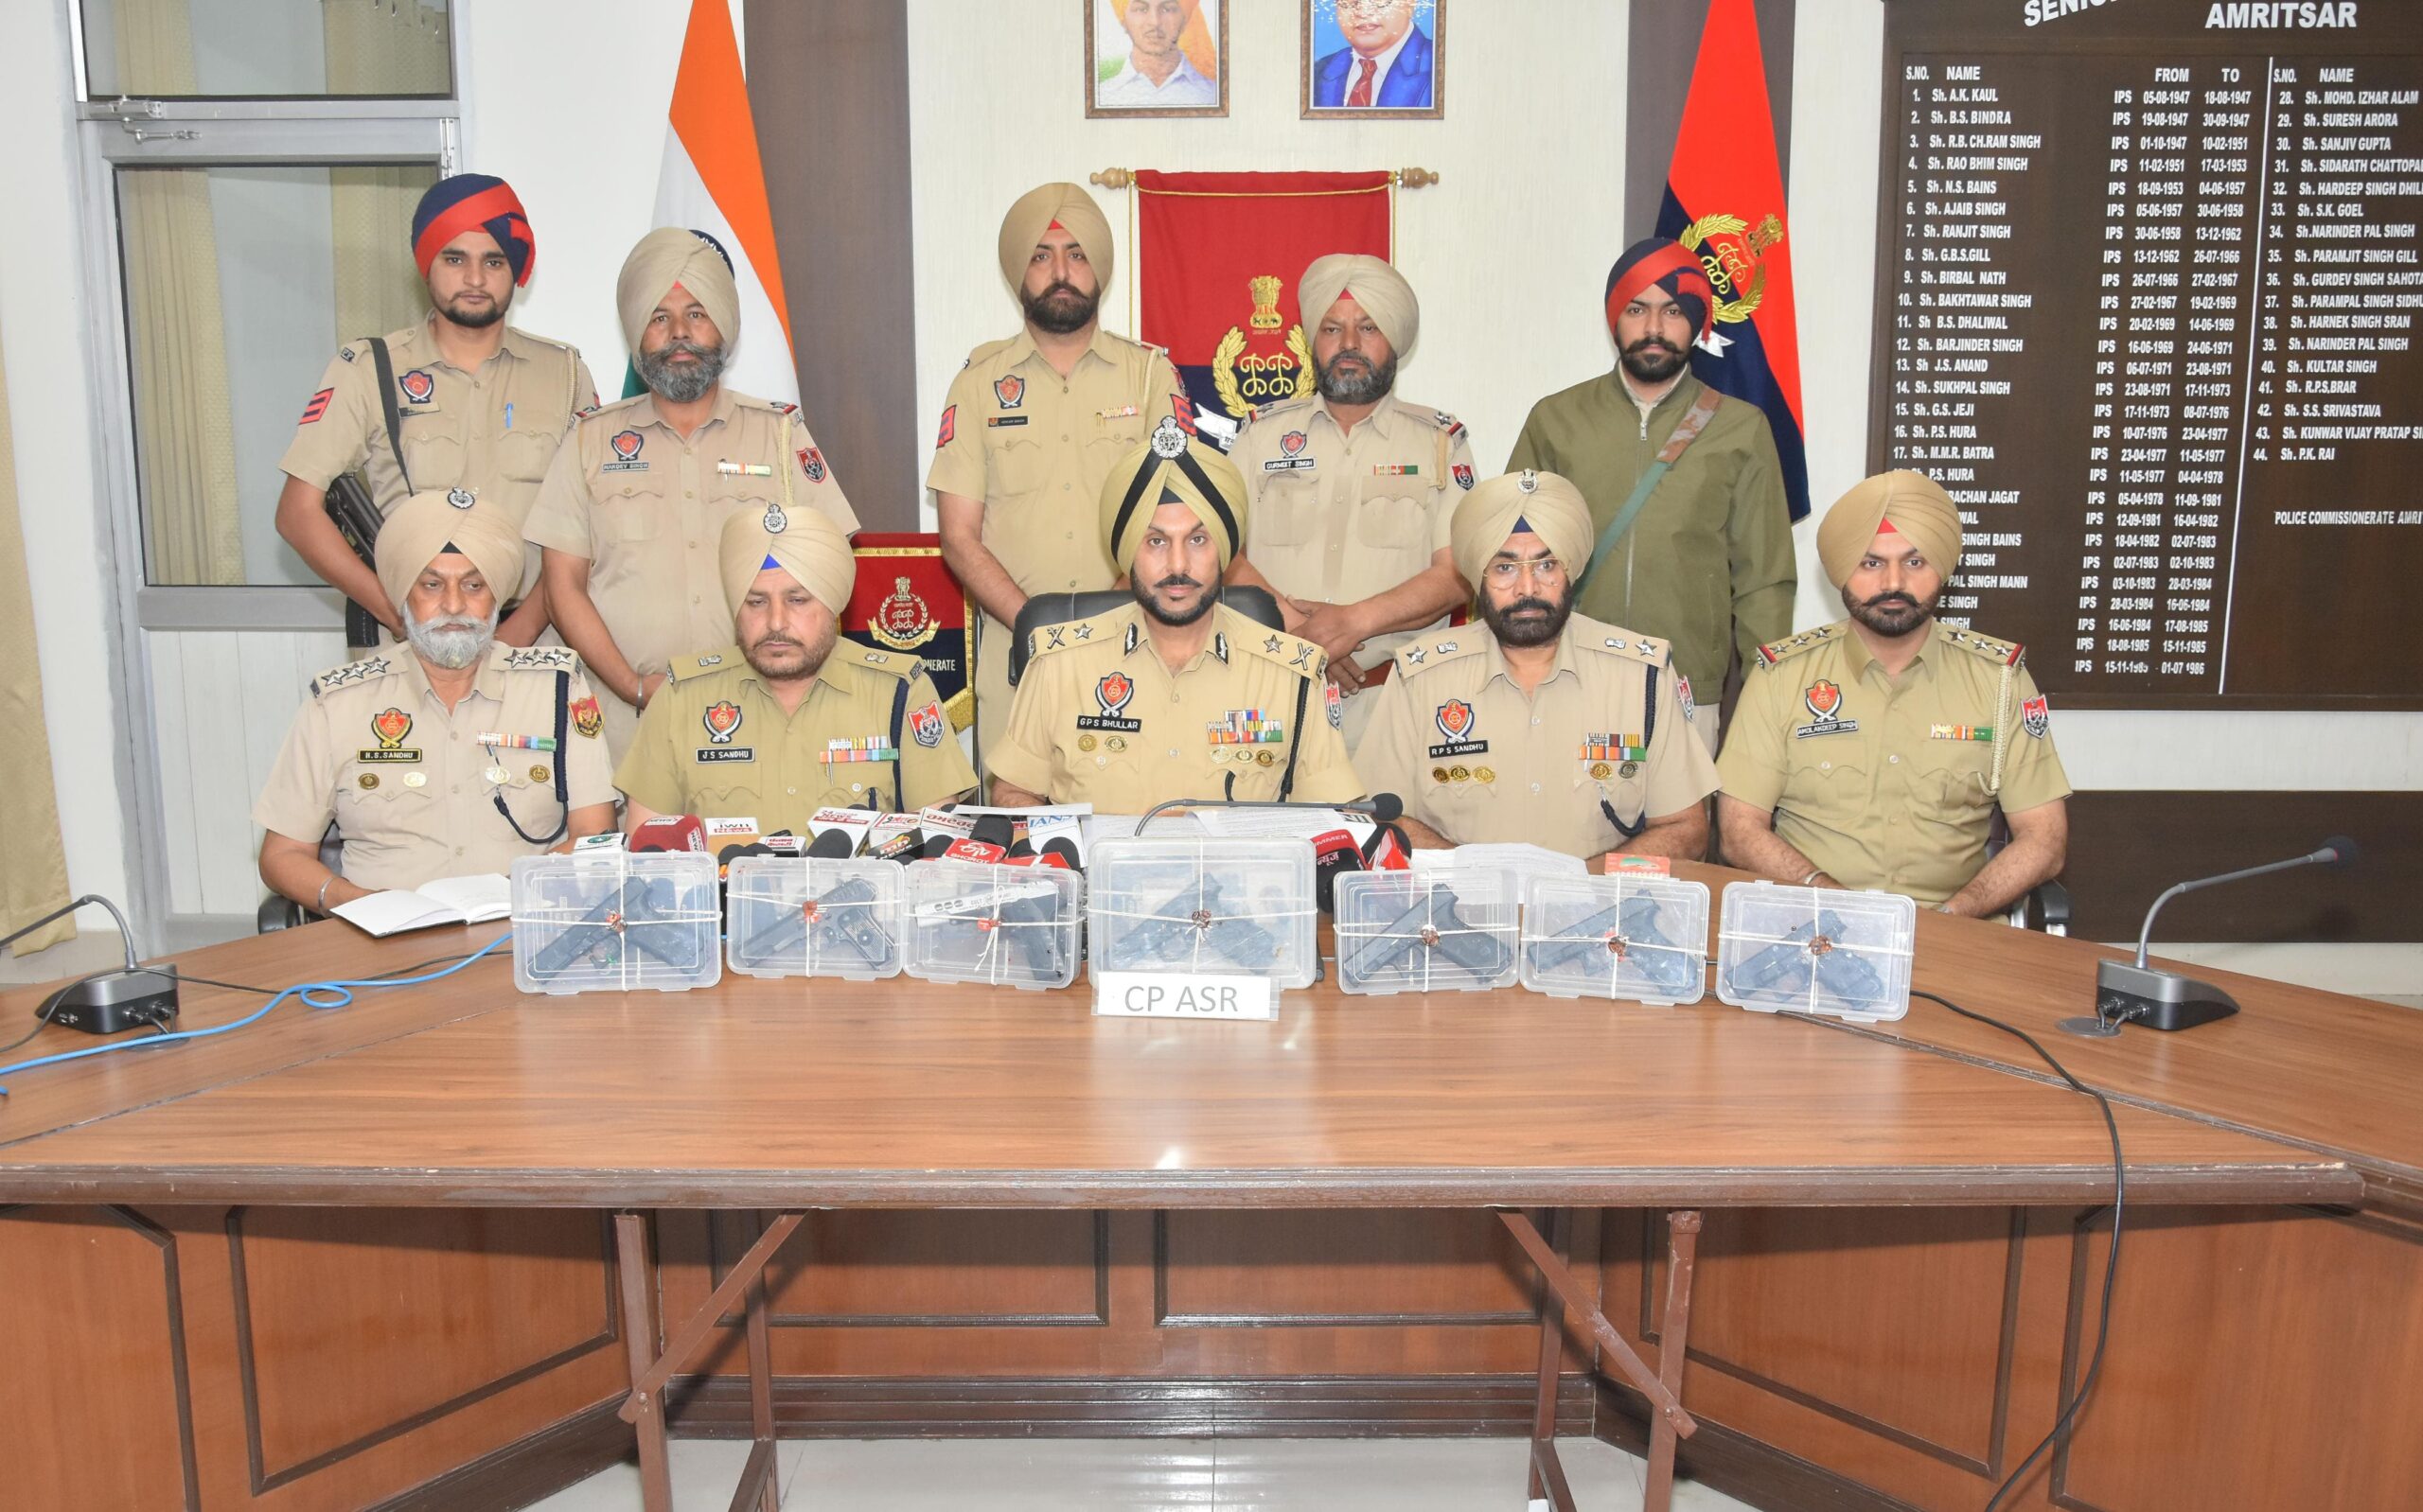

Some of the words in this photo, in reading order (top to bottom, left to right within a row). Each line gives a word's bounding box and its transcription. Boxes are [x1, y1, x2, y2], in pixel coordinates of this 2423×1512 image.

[2205, 2, 2357, 28] AMRITSAR
[1905, 65, 1929, 80] S.NO.
[1946, 66, 1981, 80] NAME
[2155, 68, 2189, 82] FROM
[2221, 68, 2239, 82] TO
[2273, 68, 2297, 82] S.NO.
[2320, 68, 2354, 82] NAME
[1913, 88, 1920, 101] 1.
[1933, 88, 1947, 102] Sh.
[1972, 88, 1998, 101] KAUL
[2114, 90, 2131, 103] IPS
[2143, 91, 2190, 104] 05-08-1947
[2204, 91, 2252, 104] 18-08-1947
[2279, 91, 2293, 104] 28.
[2307, 91, 2322, 104] Sh.
[2359, 91, 2389, 104] IZHAR
[2391, 91, 2418, 104] ALAM
[1911, 111, 1920, 124] 2.
[1932, 111, 1947, 124] Sh.
[1971, 111, 2011, 124] BINDRA
[2113, 112, 2131, 125] IPS
[2142, 113, 2188, 126] 19-08-1947
[2202, 113, 2250, 127] 30-09-1947
[2277, 114, 2291, 127] 29.
[2305, 114, 2320, 127] Sh.
[2323, 114, 2362, 127] SURESH
[2363, 114, 2397, 126] ARORA
[1910, 134, 1919, 148] 3.
[1931, 134, 1946, 148] Sh.
[2009, 134, 2041, 149] SINGH
[2112, 136, 2130, 149] IPS
[2140, 136, 2187, 149] 01-10-1947
[2202, 136, 2248, 150] 10-02-1951
[1908, 156, 1918, 169] 4.
[1929, 156, 1944, 169] Sh.
[1947, 156, 1968, 170] RAO
[1969, 157, 1995, 170] BHIM
[1997, 157, 2028, 170] SINGH
[2110, 159, 2128, 172] IPS
[2139, 159, 2184, 172] 11-02-1951
[2202, 159, 2247, 172] 17-03-1953
[1907, 180, 1917, 193] 5.
[1927, 179, 1943, 193] Sh.
[1967, 181, 1997, 194] BAINS
[2109, 182, 2126, 195] IPS
[2137, 182, 2184, 195] 18-09-1953
[2200, 182, 2246, 195] 04-06-1957
[2271, 202, 2285, 216] 33.
[2298, 203, 2313, 217] Sh.
[2338, 203, 2363, 217] GOEL
[1906, 223, 1915, 237] 7.
[1924, 224, 1940, 237] Sh.
[1942, 224, 1978, 237] RANJIT
[1979, 225, 2011, 238] SINGH
[2106, 226, 2123, 239] IPS
[2135, 226, 2181, 239] 30-06-1958
[2196, 227, 2241, 240] 13-12-1962
[2269, 225, 2283, 238] 34.
[2363, 224, 2381, 237] PAL
[2384, 224, 2414, 237] SINGH
[1904, 270, 1913, 283] 9.
[1921, 271, 1937, 284] Sh.
[1939, 271, 1975, 284] BIRBAL
[1979, 272, 2007, 285] NATH
[2102, 273, 2120, 287] IPS
[2132, 273, 2178, 287] 26-07-1966
[2192, 273, 2238, 287] 27-02-1967
[1898, 292, 1912, 307] 10.
[1920, 293, 1937, 307] Sh.
[1938, 293, 1999, 308] BAKHTAWAR
[2001, 294, 2031, 308] SINGH
[2101, 296, 2118, 309] IPS
[2131, 295, 2177, 308] 27-02-1967
[2190, 296, 2237, 309] 19-02-1969
[2263, 316, 2277, 329] 38.
[2291, 316, 2307, 328] Sh.
[2309, 315, 2349, 328] HARNEK
[2351, 315, 2381, 328] SINGH
[2384, 315, 2411, 328] SRAN
[1897, 338, 1911, 351] 12.
[1918, 338, 1933, 351] Sh.
[1936, 338, 1990, 351] BARJINDER
[1992, 339, 2024, 352] SINGH
[2098, 340, 2115, 353] IPS
[2129, 341, 2174, 354] 16-06-1969
[2187, 341, 2233, 354] 24-06-1971
[2261, 360, 2275, 373] 40.
[2288, 360, 2303, 373] Sh.
[2307, 360, 2344, 373] KULTAR
[2346, 360, 2377, 373] SINGH
[2257, 404, 2272, 416] 42.
[2285, 404, 2299, 416] Sh.
[2323, 404, 2380, 417] SRIVASTAVA
[1895, 447, 1907, 459] 17.
[1912, 446, 1928, 459] Sh.
[1963, 447, 1994, 459] BATRA
[2091, 447, 2109, 460] IPS
[2121, 448, 2167, 462] 23-04-1977
[2180, 449, 2225, 462] 11-05-1977
[2254, 448, 2268, 461] 44.
[2282, 448, 2296, 460] Sh.
[2318, 448, 2335, 460] RAI
[2276, 511, 2307, 524] POLICE
[2308, 511, 2395, 524] COMMISSIONERATE
[2397, 511, 2423, 524] AMRI
[1961, 533, 1990, 546] SINGH
[1992, 534, 2022, 546] BAINS
[2085, 534, 2102, 546] IPS
[2114, 535, 2160, 547] 18-04-1982
[2171, 535, 2216, 548] 02-07-1983
[1948, 575, 1966, 588] PAL
[1968, 575, 1997, 588] SINGH
[1999, 576, 2028, 589] MANN
[2081, 576, 2098, 589] IPS
[2113, 577, 2155, 589] 03-10-1983
[2168, 577, 2212, 590] 28-03-1984
[1102, 719, 1139, 730] BHULLAR
[718, 749, 750, 759] SANDHU
[1454, 743, 1484, 753] SANDHU
[1124, 985, 1165, 1012] CP
[1176, 985, 1238, 1012] ASR
